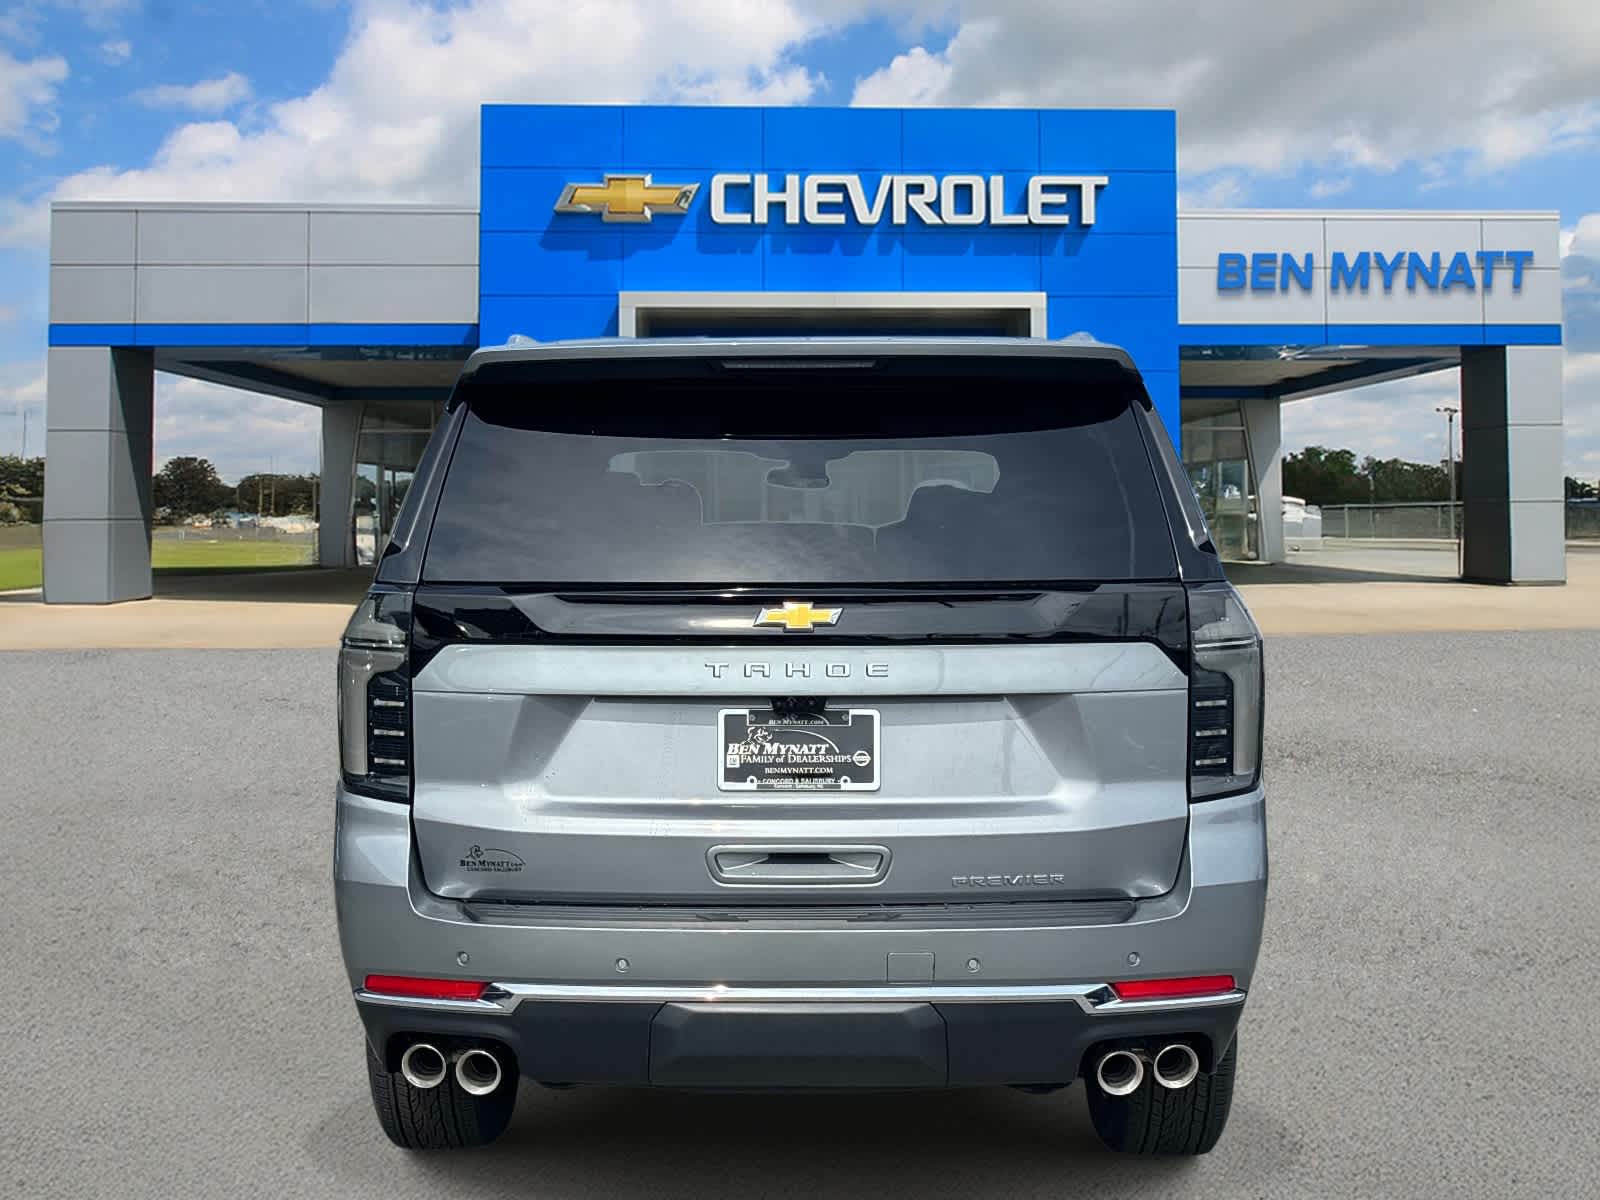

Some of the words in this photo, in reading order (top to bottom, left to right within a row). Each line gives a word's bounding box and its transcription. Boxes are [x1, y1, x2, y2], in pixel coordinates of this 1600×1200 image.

[710, 173, 1109, 226] CHEVROLET
[1217, 251, 1313, 291] BEN
[1330, 250, 1534, 291] MYNATT
[704, 662, 889, 679] TAHOE
[727, 743, 760, 755] BEN
[763, 742, 829, 755] MYNATT
[740, 754, 774, 764] FAMILY
[788, 754, 851, 764] DEALERSHIPS
[951, 873, 1065, 888] PREMIER
